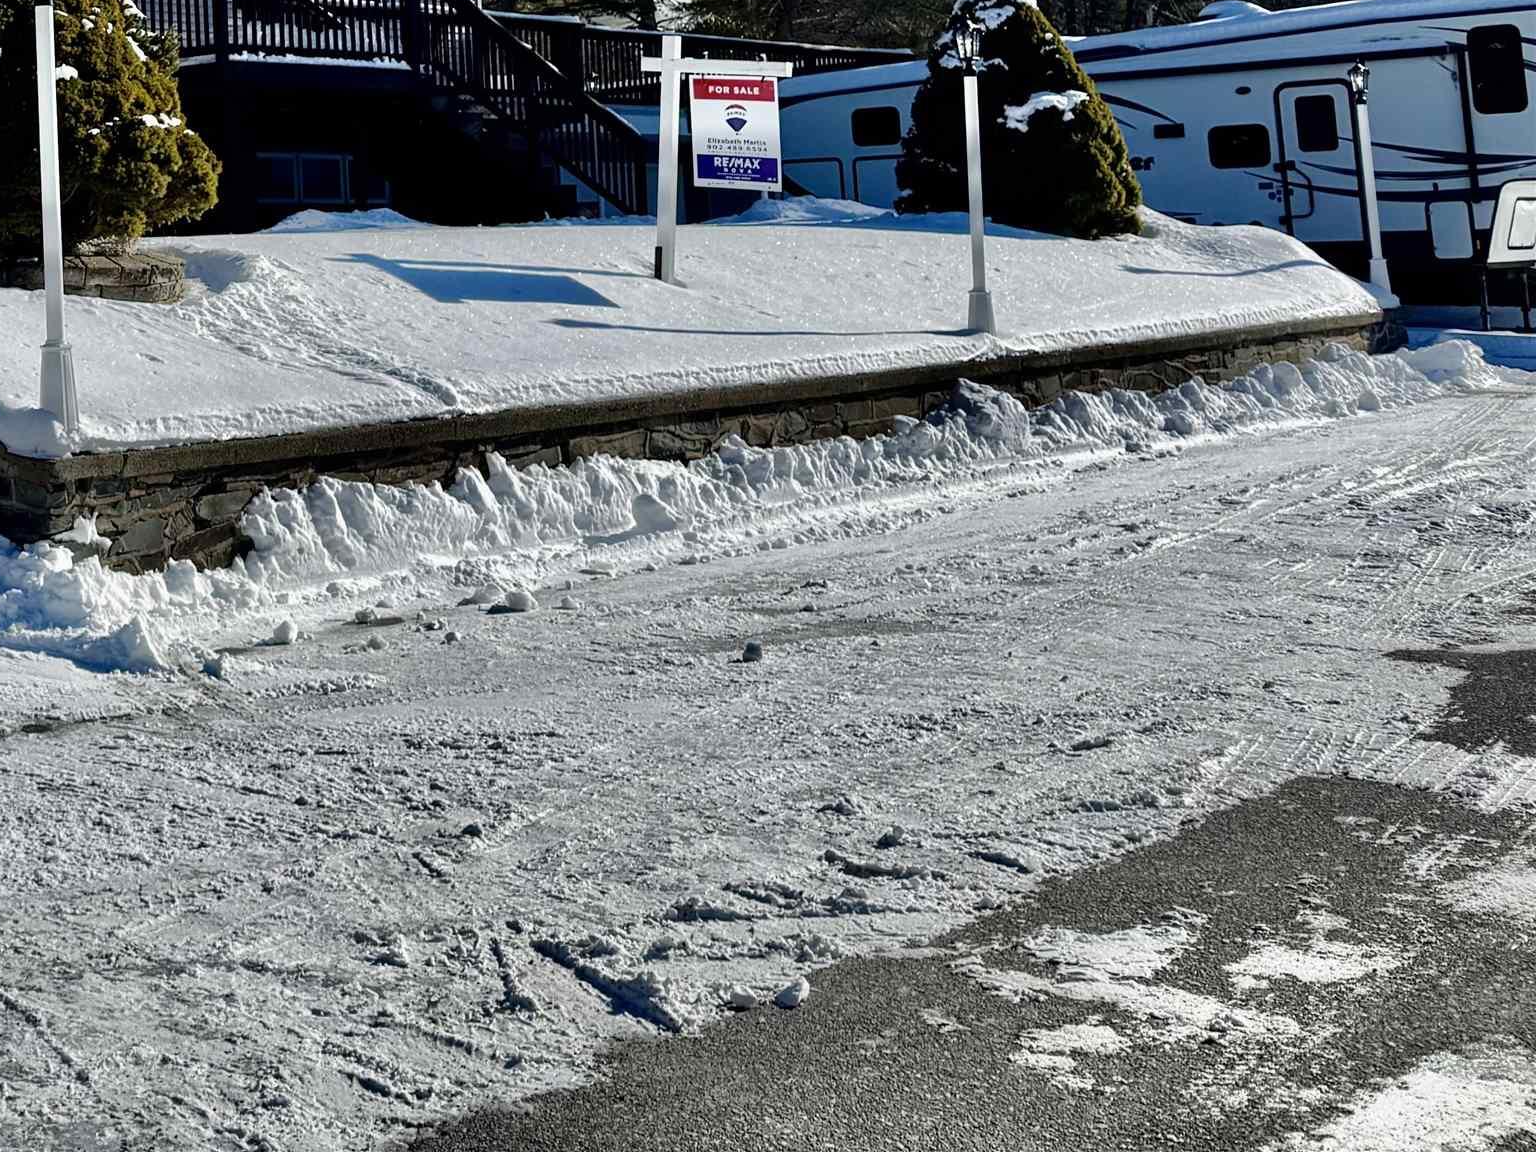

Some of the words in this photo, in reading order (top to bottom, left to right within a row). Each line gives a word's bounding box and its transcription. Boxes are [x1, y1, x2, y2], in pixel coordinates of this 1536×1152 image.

[708, 85, 730, 94] FOR
[733, 86, 760, 95] SALE
[714, 156, 761, 169] RE/MAX
